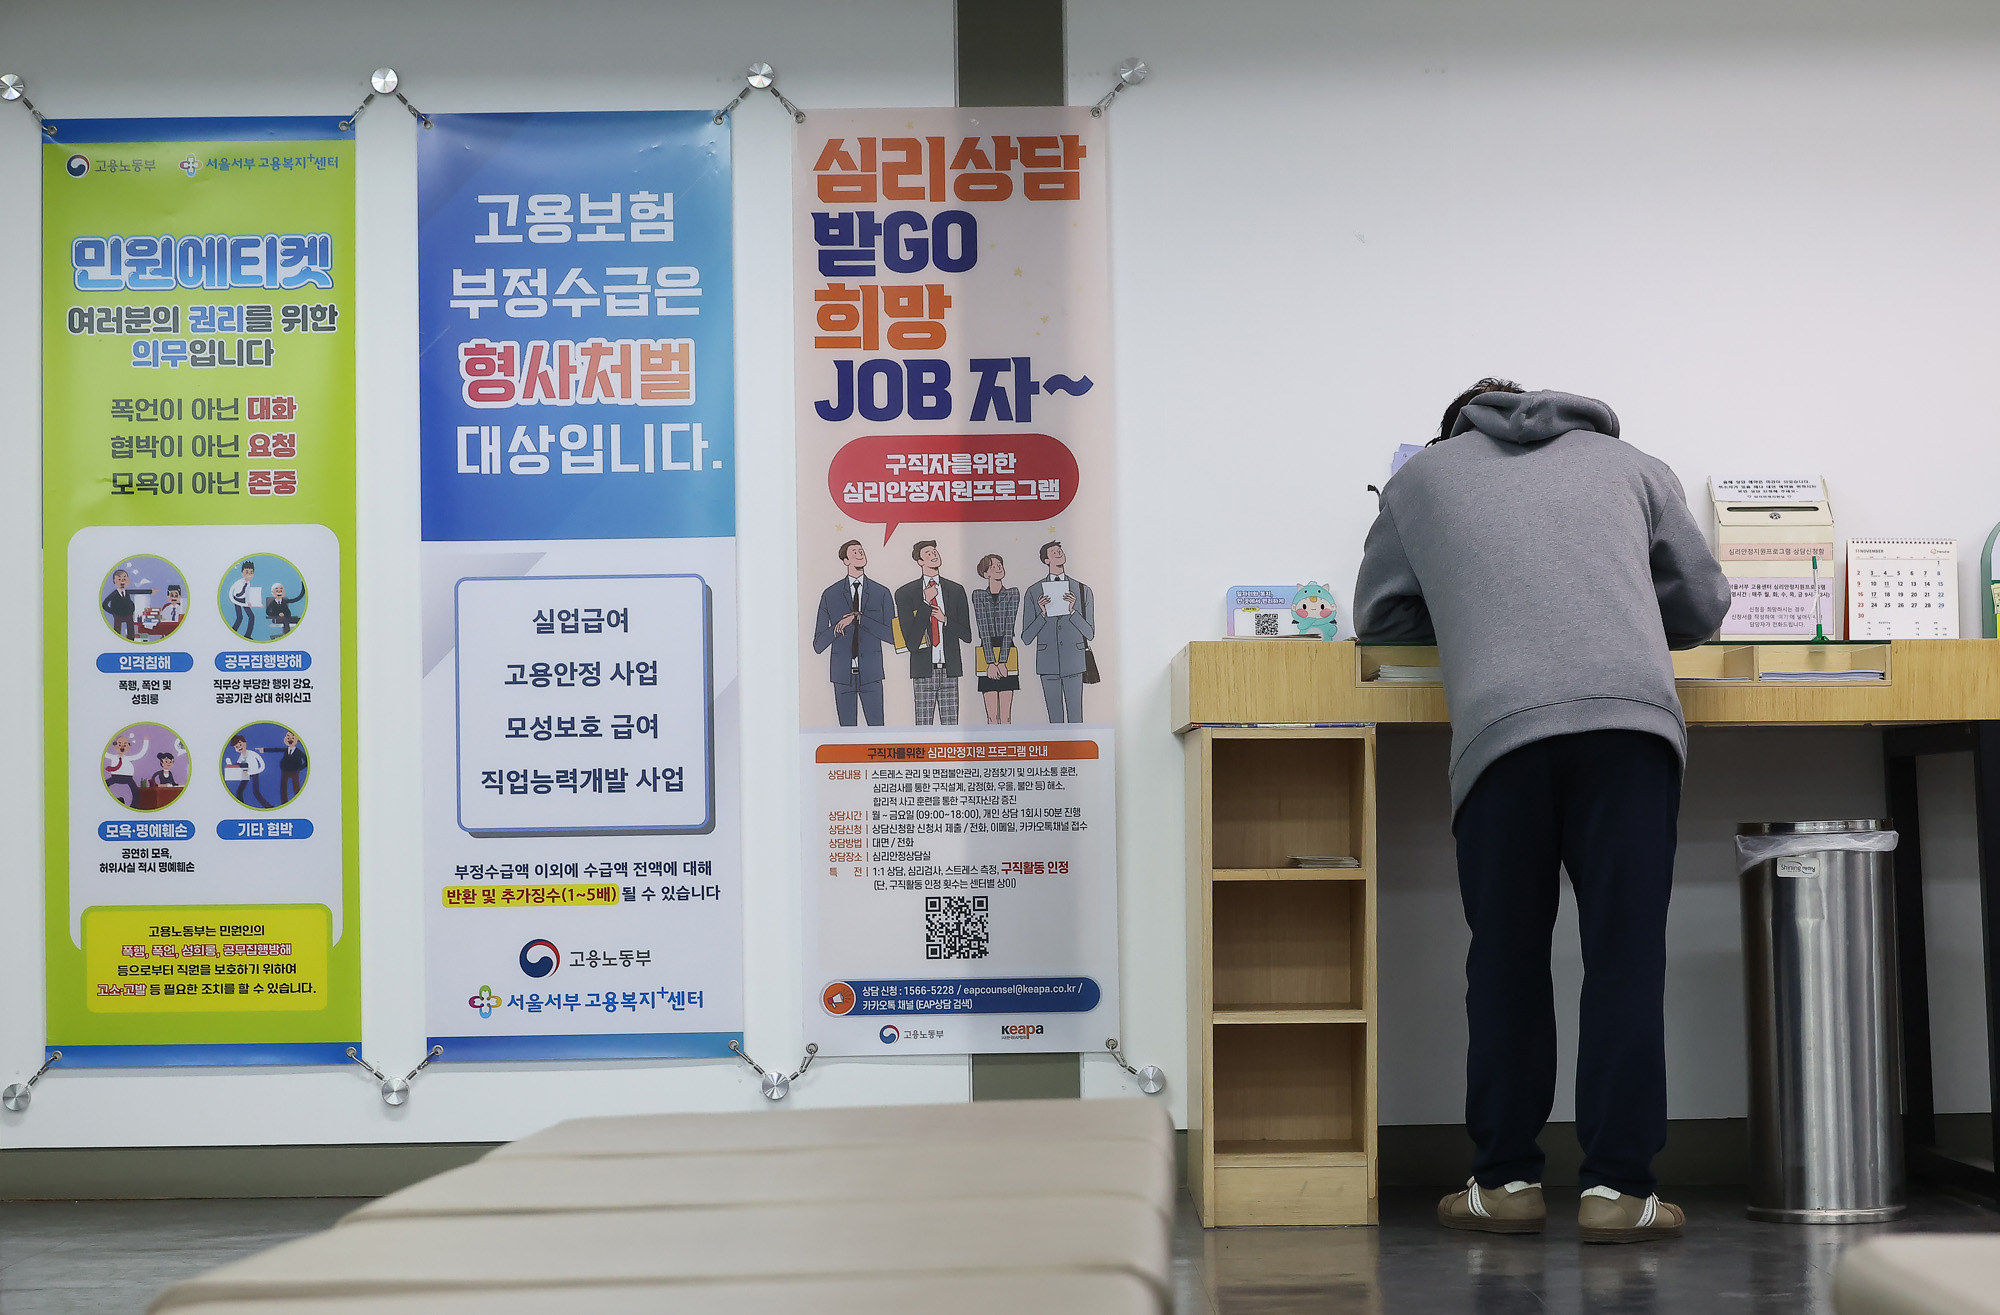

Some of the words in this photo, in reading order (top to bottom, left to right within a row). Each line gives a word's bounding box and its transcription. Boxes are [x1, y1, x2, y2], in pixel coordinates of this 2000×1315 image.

[94, 160, 155, 173] 고용노동부
[206, 158, 256, 171] 서울서부
[813, 135, 1086, 203] 심리상담
[474, 191, 674, 244] 고용보험
[811, 210, 977, 276] 받GO
[71, 232, 334, 292] 민원에티켓
[449, 266, 702, 320] 부정수급은
[68, 305, 180, 335] 여러분의
[188, 304, 273, 334] 권리를
[280, 303, 339, 333] 위한
[815, 283, 952, 350] 희망
[132, 338, 275, 368] 의무입니다
[457, 338, 696, 409] 형사처벌
[814, 359, 952, 421] JOB
[111, 399, 182, 422] 폭언이
[192, 398, 239, 420] 아닌
[246, 396, 298, 421] 대화
[111, 436, 182, 458] 협박이
[192, 435, 239, 458] 아닌
[247, 432, 297, 459] 요청
[457, 422, 722, 475] 대상입니다.
[111, 472, 182, 495] 모욕이
[192, 472, 239, 494] 아닌
[247, 470, 298, 496] 존중
[533, 608, 628, 634] 실업급여
[120, 656, 170, 670] 인격침해
[225, 654, 301, 669] 공무집행방해
[505, 662, 600, 687] 고용안정
[610, 661, 657, 686] 사업
[119, 680, 139, 691] 폭행,
[142, 680, 159, 690] 폭언
[163, 680, 171, 690] 및
[214, 679, 240, 690] 직무상
[243, 679, 270, 689] 부당한
[293, 679, 313, 689] 강요,
[132, 694, 158, 704] 성희롱
[216, 693, 252, 704] 공공기관
[255, 693, 272, 703] 상대
[276, 693, 311, 703] 허위신고
[506, 716, 602, 740] 모성보호
[611, 714, 658, 739] 급여
[927, 746, 985, 758] 심리안정지원
[988, 746, 1026, 757] 프로그램
[1029, 745, 1048, 757] 안내
[482, 768, 628, 794] 직업능력개발
[636, 767, 683, 792] 사업
[828, 770, 860, 780] 상담내용
[872, 770, 903, 779] 스트레스
[905, 770, 920, 778] 관리
[923, 770, 930, 778] 및
[1017, 768, 1024, 777] 및
[1027, 767, 1058, 776] 의사소통
[829, 811, 862, 821] 상담시간
[872, 811, 880, 820] 월
[890, 810, 914, 820] 금요일
[917, 809, 981, 820] (09:00~18:00),
[1002, 808, 1018, 818] 상담
[1044, 808, 1062, 817] 50분
[1065, 807, 1080, 817] 진행
[238, 823, 263, 836] 기타
[267, 822, 293, 836] 협박
[829, 825, 861, 834] 상담신청
[872, 824, 915, 834] 상담신청함
[917, 824, 942, 833] 신청서
[970, 823, 988, 832] 전화,
[1020, 821, 1068, 831] 카카오톡채널
[1072, 821, 1087, 831] 접수
[829, 839, 861, 848] 상담방법
[873, 838, 889, 847] 대면
[898, 838, 914, 847] 전화
[122, 848, 148, 859] 공연히
[152, 848, 172, 859] 모욕,
[830, 852, 862, 862] 상담장소
[873, 851, 930, 861] 심리안정상담실
[100, 863, 135, 873] 허위사실
[138, 862, 156, 872] 적시
[159, 862, 194, 872] 명예훼손
[455, 864, 528, 880] 부정수급액
[535, 863, 578, 878] 이외에
[584, 862, 627, 878] 수급액
[634, 861, 677, 876] 전액에
[684, 861, 711, 876] 대해
[887, 866, 905, 876] 상담,
[908, 865, 943, 876] 심리검사,
[946, 866, 978, 875] 스트레스
[1002, 862, 1044, 874] 구직활동
[1048, 861, 1068, 874] 인정
[448, 888, 477, 904] 반환
[482, 889, 497, 905] 및
[501, 887, 616, 904] 추가징수(1~5배)
[622, 886, 636, 901] 될
[642, 887, 656, 901] 수
[662, 885, 720, 901] 있습니다
[149, 926, 216, 937] 고용노동부는
[220, 925, 264, 936] 민원인의
[122, 945, 149, 959] 폭행,
[152, 944, 179, 959] 폭언,
[181, 944, 220, 958] 성희롱,
[223, 943, 292, 956] 공무집행방해
[570, 950, 651, 968] 고용노동부
[118, 965, 173, 976] 등으로부터
[178, 965, 210, 975] 직원을
[215, 964, 259, 974] 보호하기
[263, 964, 296, 974] 위하여
[150, 984, 160, 995] 등
[164, 984, 198, 995] 필요한
[202, 984, 235, 994] 조치를
[238, 983, 249, 994] 할
[253, 983, 264, 994] 수
[268, 983, 316, 994] 있습니다.
[862, 986, 879, 996] 상담
[881, 986, 898, 996] 신청
[904, 986, 954, 995] 1566-5228
[964, 984, 1076, 996] eapcounsel@keapa.co.kr
[507, 994, 581, 1012] 서울서부
[863, 1000, 895, 1010] 카카오톡
[898, 1000, 913, 1010] 채널
[916, 999, 951, 1010] (EAP상담
[954, 999, 972, 1009] 검색)
[904, 1030, 944, 1039] 고용노동부
[1002, 1025, 1043, 1039] keapa
